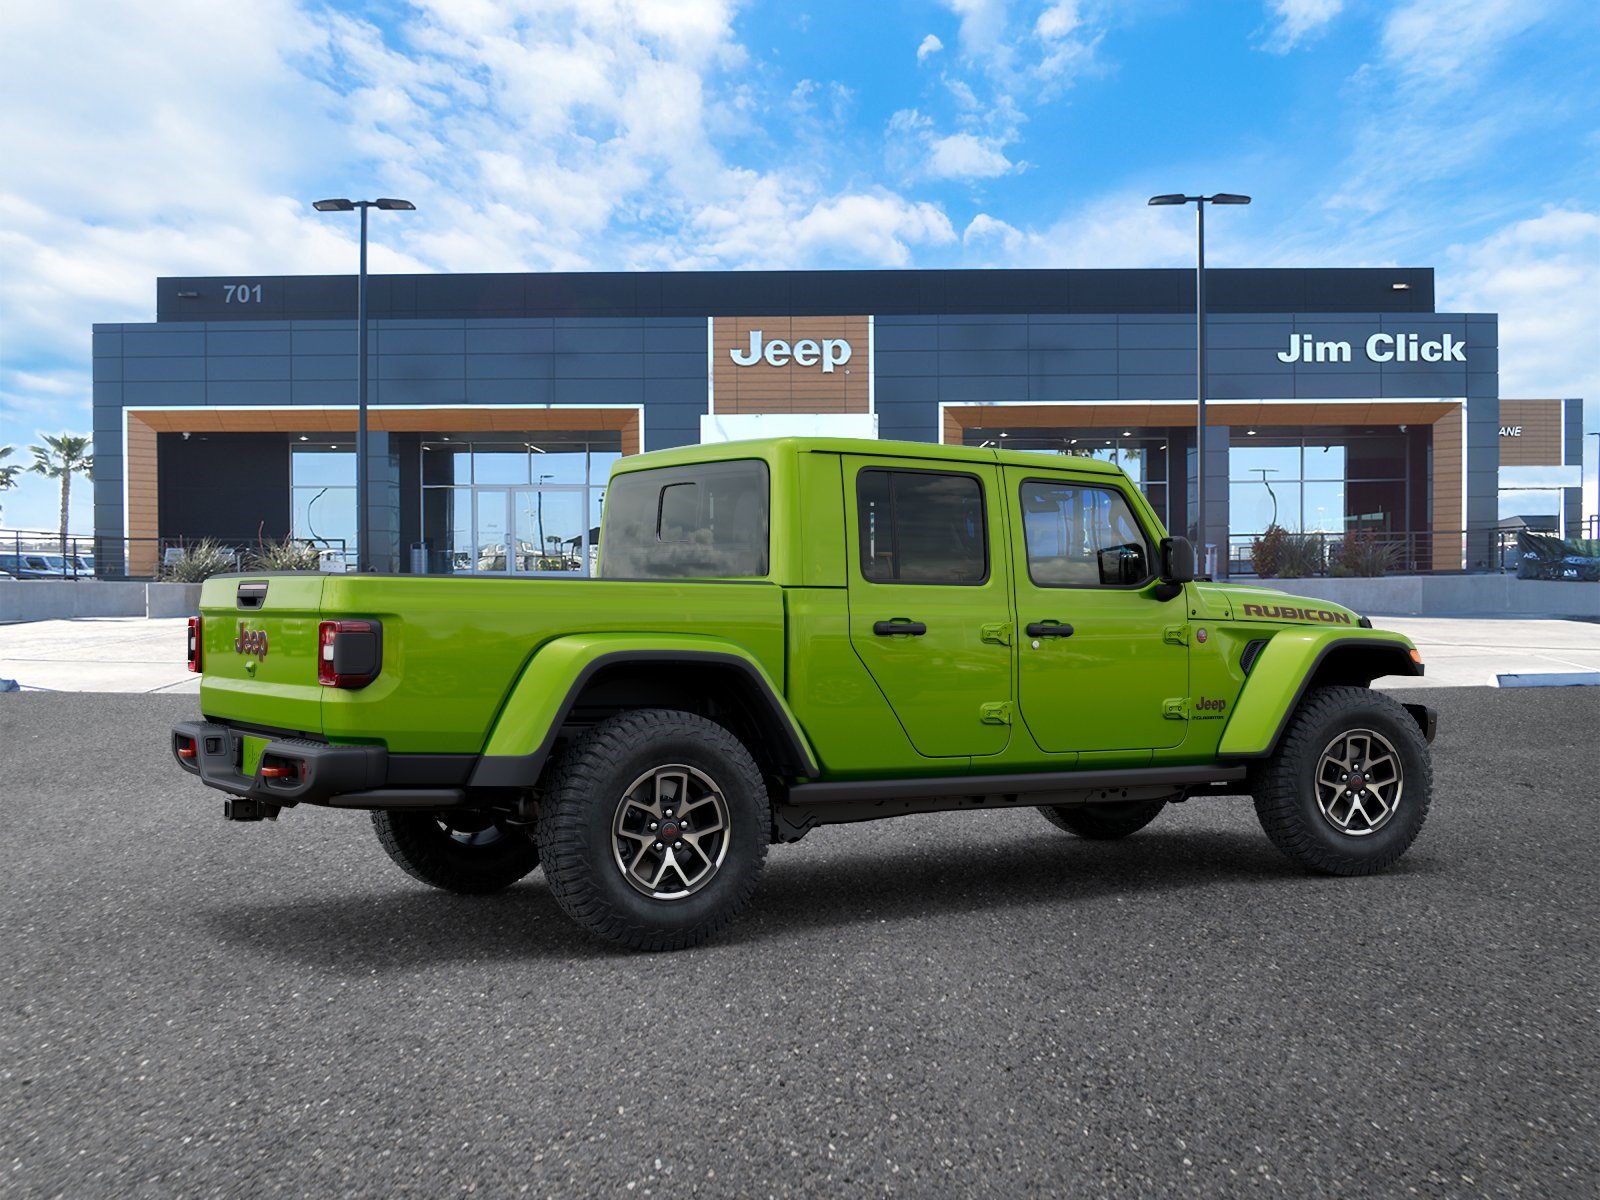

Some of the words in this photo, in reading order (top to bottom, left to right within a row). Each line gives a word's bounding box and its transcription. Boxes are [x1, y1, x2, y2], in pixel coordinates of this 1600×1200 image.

[223, 284, 262, 304] 701
[729, 330, 852, 373] Jeep
[1277, 333, 1351, 363] Jim
[1366, 333, 1467, 363] Click
[1243, 603, 1351, 625] RUBICON
[234, 620, 268, 663] Jeep
[1195, 695, 1226, 713] Jeep
